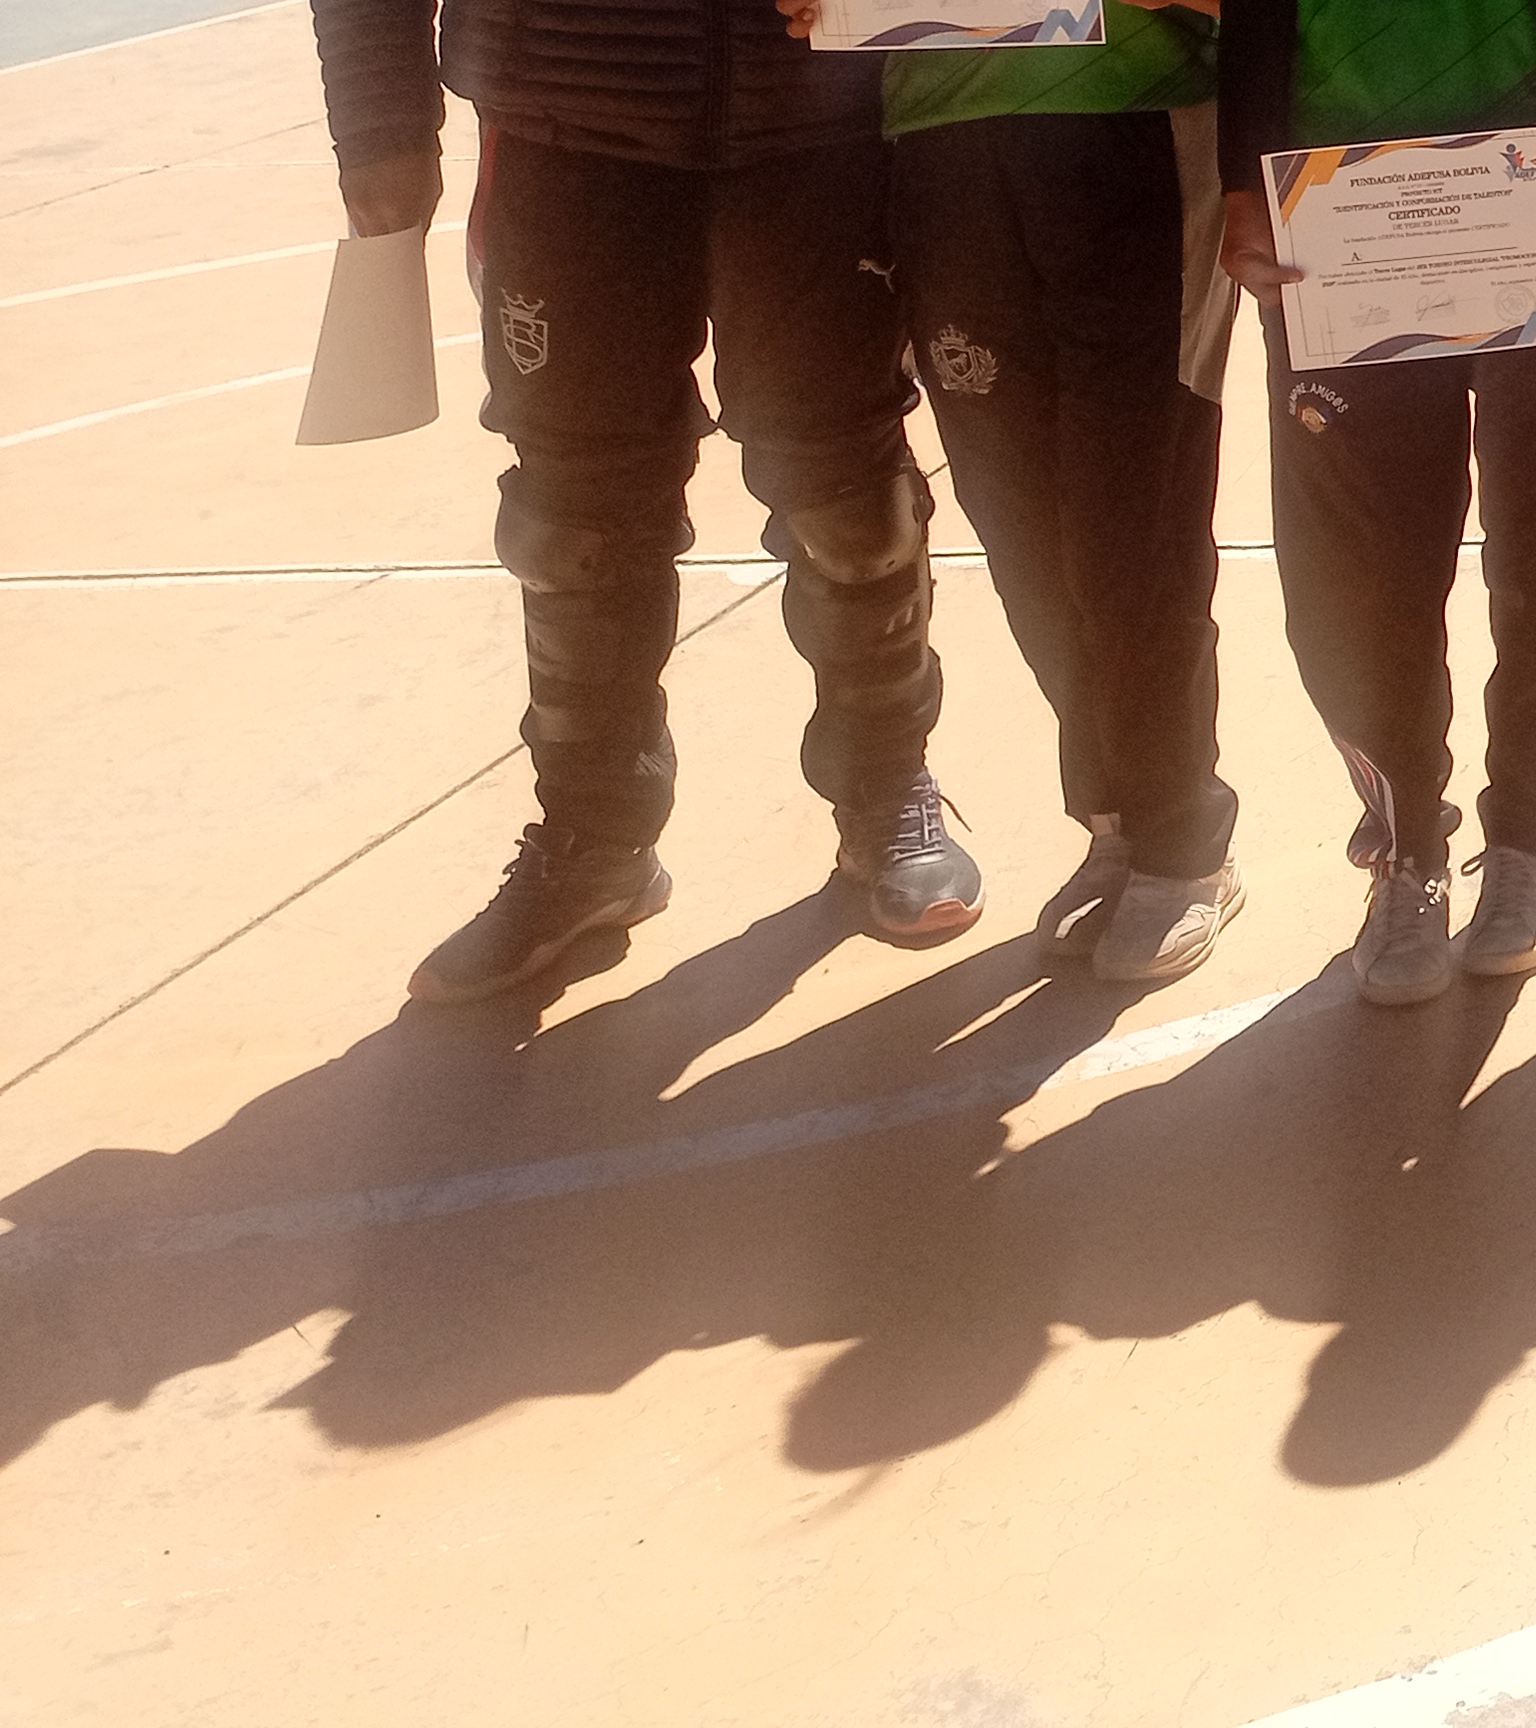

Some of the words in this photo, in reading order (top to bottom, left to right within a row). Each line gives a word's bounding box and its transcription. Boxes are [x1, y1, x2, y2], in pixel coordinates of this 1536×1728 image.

[1349, 172, 1406, 187] FUNDACIÓN
[1406, 169, 1451, 182] ADEFUSA
[1452, 165, 1490, 177] BOLIVIA
[1387, 204, 1461, 221] CERTIFICADO
